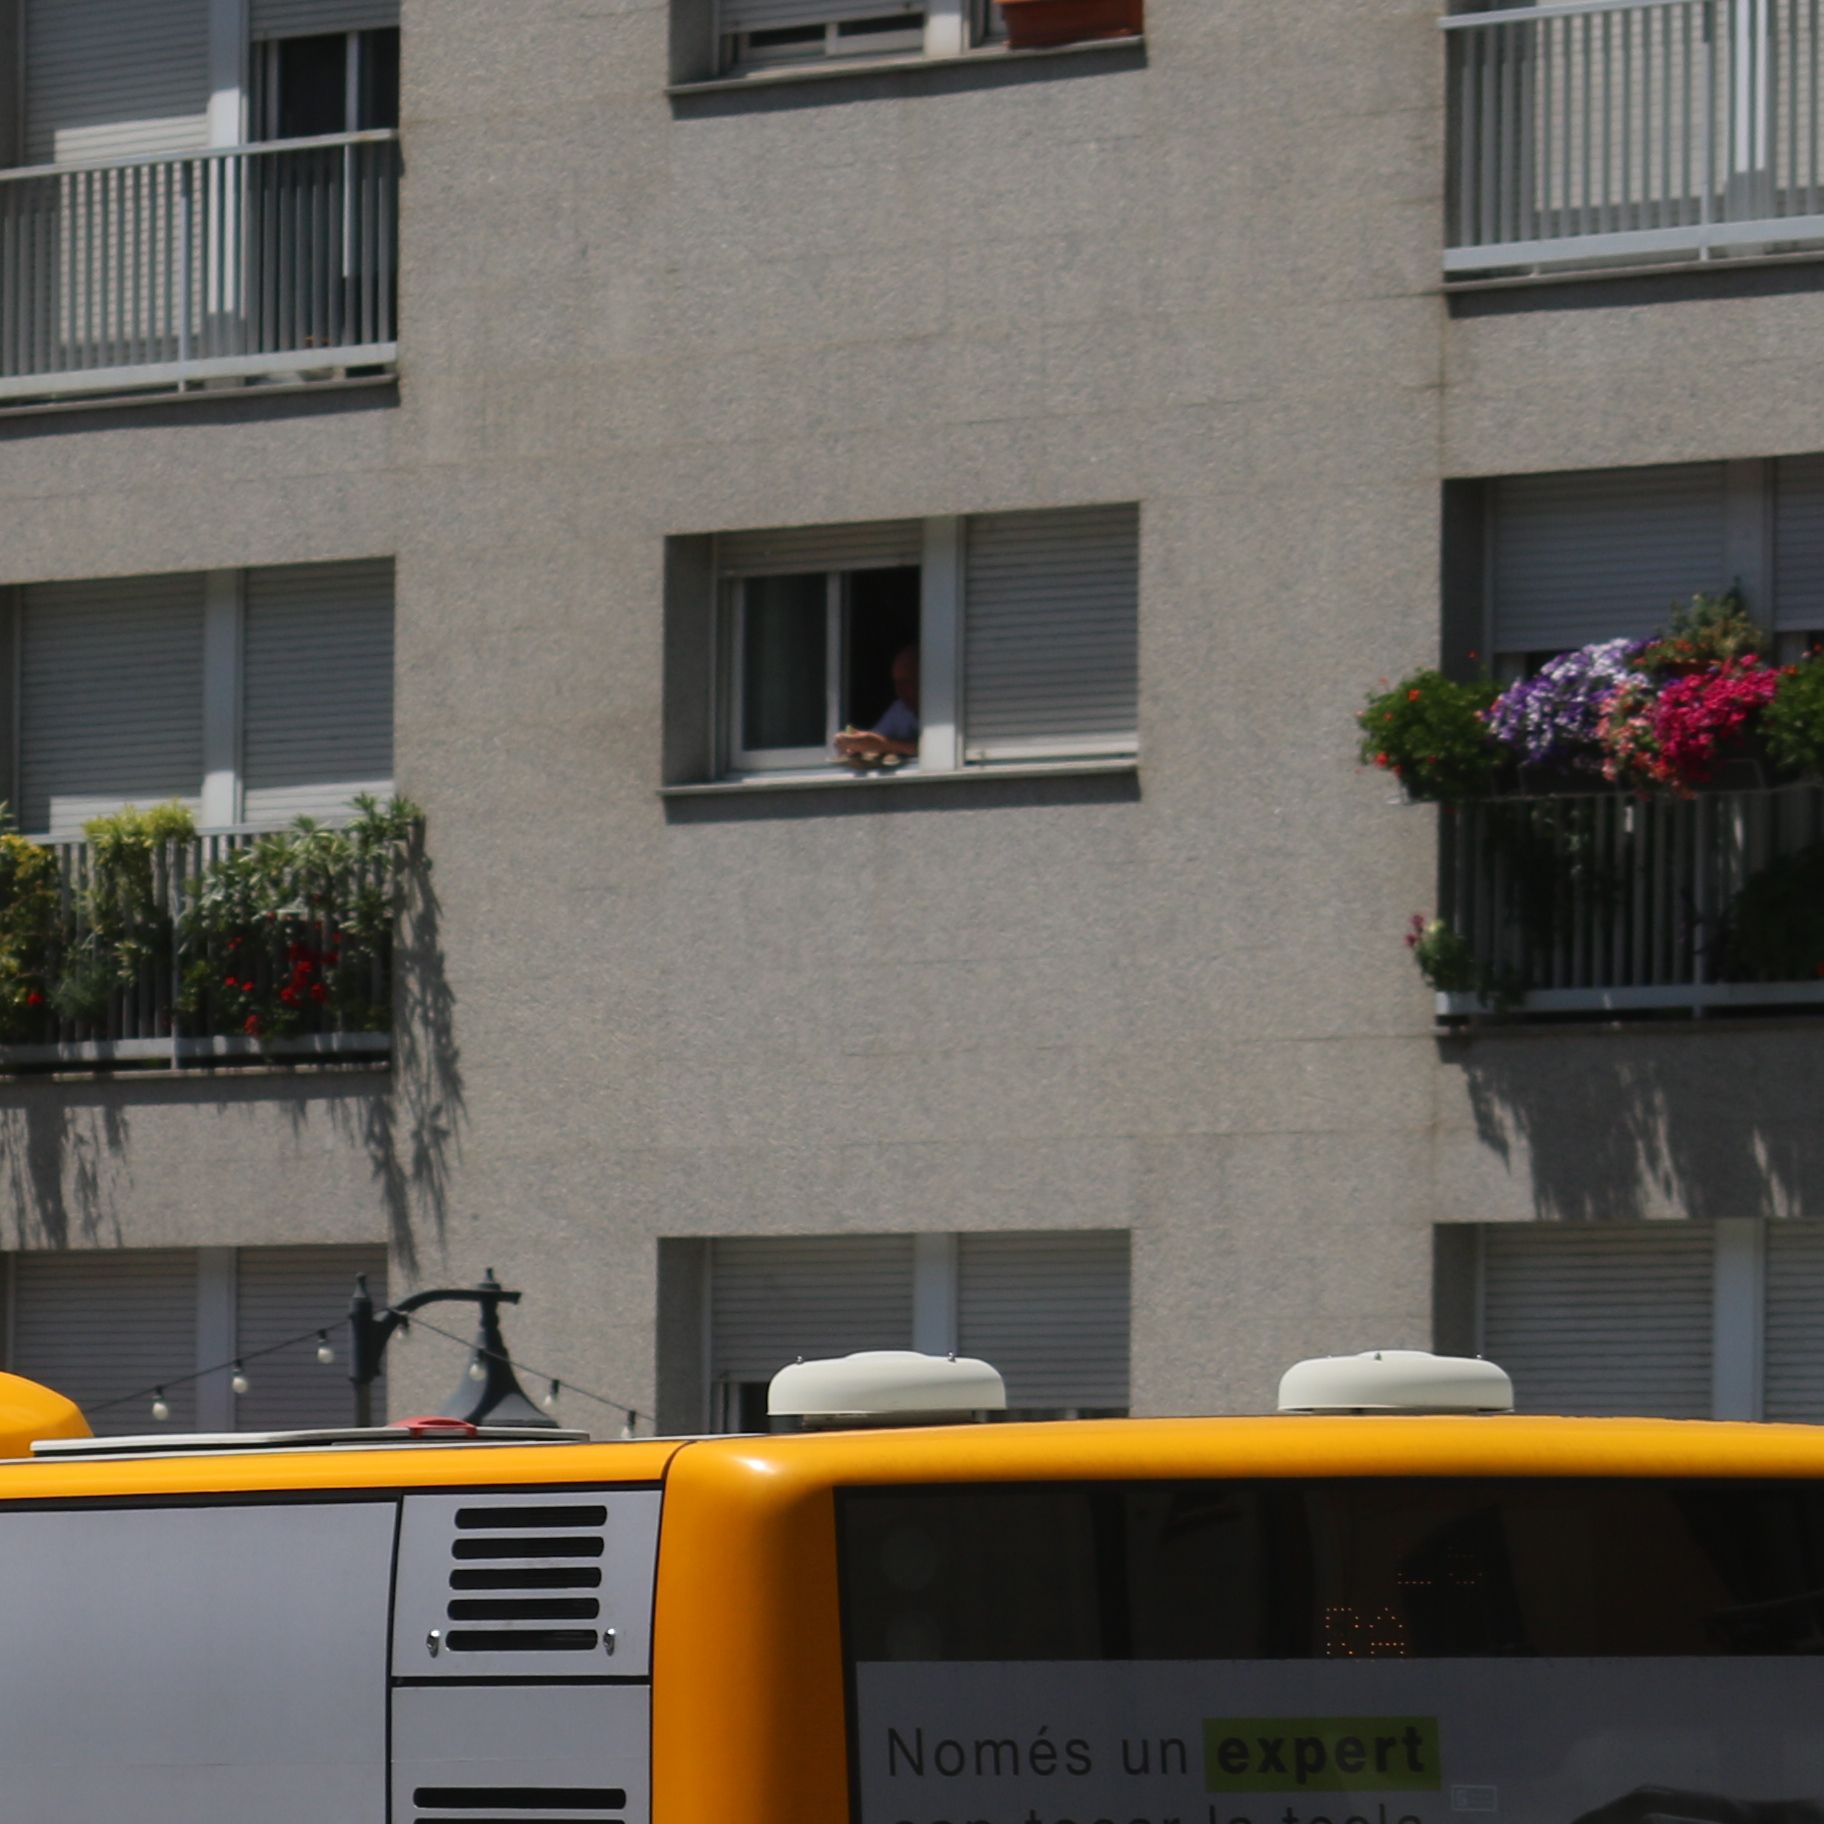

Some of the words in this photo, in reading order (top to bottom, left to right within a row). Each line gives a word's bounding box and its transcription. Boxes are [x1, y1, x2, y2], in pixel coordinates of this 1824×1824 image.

[887, 1725, 1092, 1777] Només
[1122, 1735, 1189, 1775] un
[1217, 1724, 1425, 1785] expert
